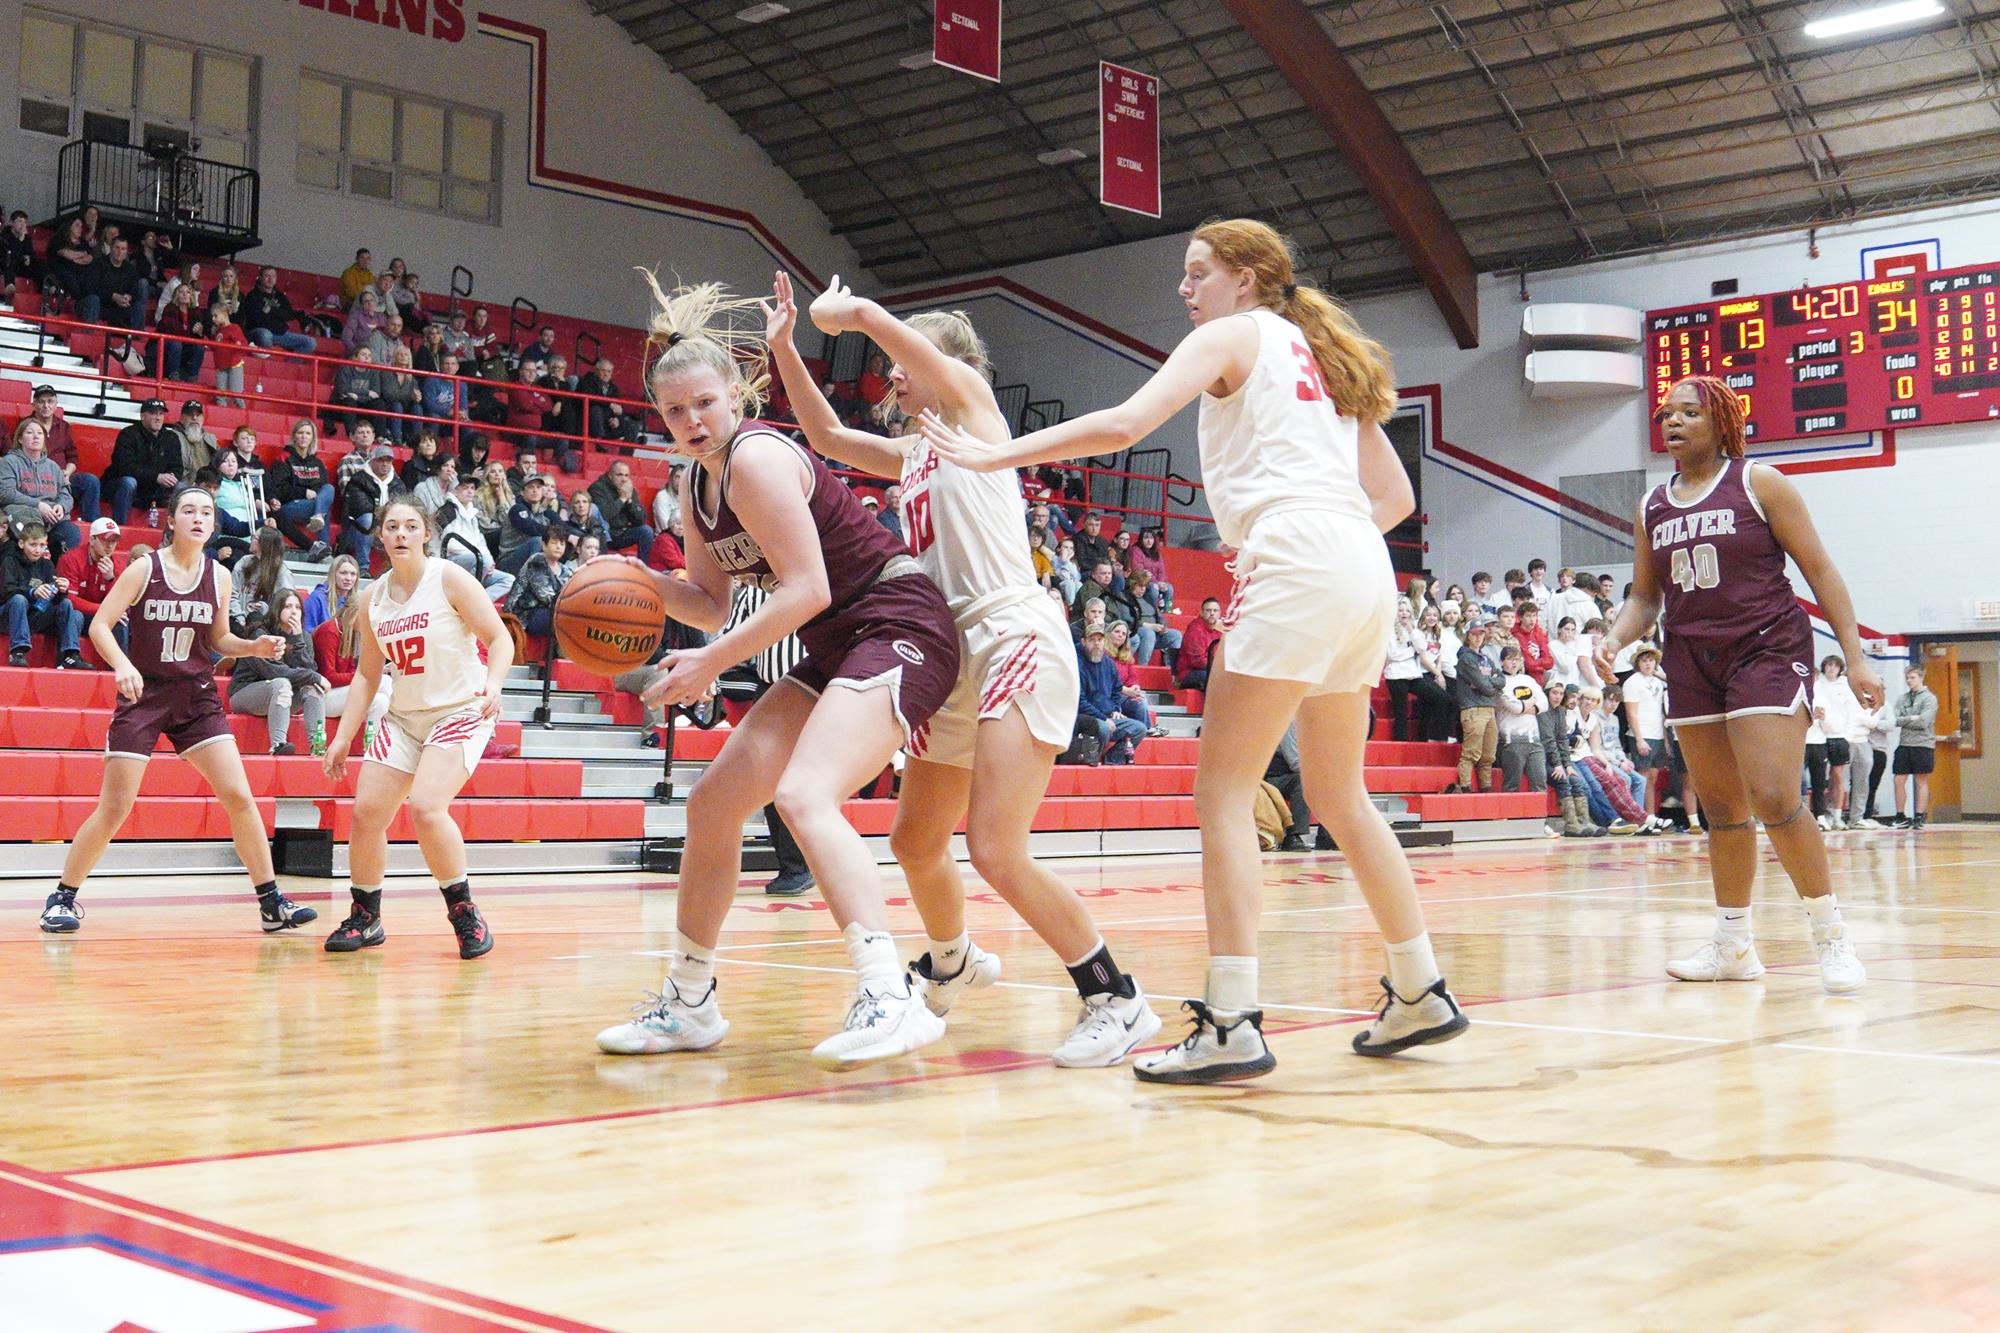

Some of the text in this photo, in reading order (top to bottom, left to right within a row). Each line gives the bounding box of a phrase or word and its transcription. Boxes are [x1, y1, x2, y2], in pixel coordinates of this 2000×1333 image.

[1120, 76, 1139, 91] GIRLS
[1121, 91, 1138, 105] SWIM
[1868, 280, 1905, 296] EAGLES
[1792, 286, 1859, 321] 4:20
[1939, 292, 1994, 311] 3 9 0
[1878, 299, 1917, 332] 34
[1962, 311, 1972, 324] 0
[1986, 308, 1995, 321] 3
[1680, 332, 1689, 345] 6
[1740, 318, 1764, 350] 13
[1850, 330, 1864, 354] 3
[1963, 327, 1973, 341] 0
[1987, 325, 1996, 338] 0
[1660, 345, 1710, 362] 11 3 3
[1799, 339, 1836, 359] period
[1682, 362, 1690, 375] 3
[1886, 354, 1916, 370] fouls
[1935, 363, 1951, 376] 40
[1989, 357, 1998, 371] 2
[1726, 374, 1753, 388] fouls
[1799, 363, 1838, 382] player
[1897, 376, 1914, 399] 0
[1891, 407, 1916, 420] won
[1805, 415, 1835, 432] game
[906, 488, 935, 558] 10
[1652, 509, 1736, 551] CULVER
[1671, 543, 1720, 592] 40
[144, 599, 212, 624] CULVER
[160, 626, 196, 662] 10
[586, 624, 656, 654] Wilson
[386, 636, 425, 676] 42
